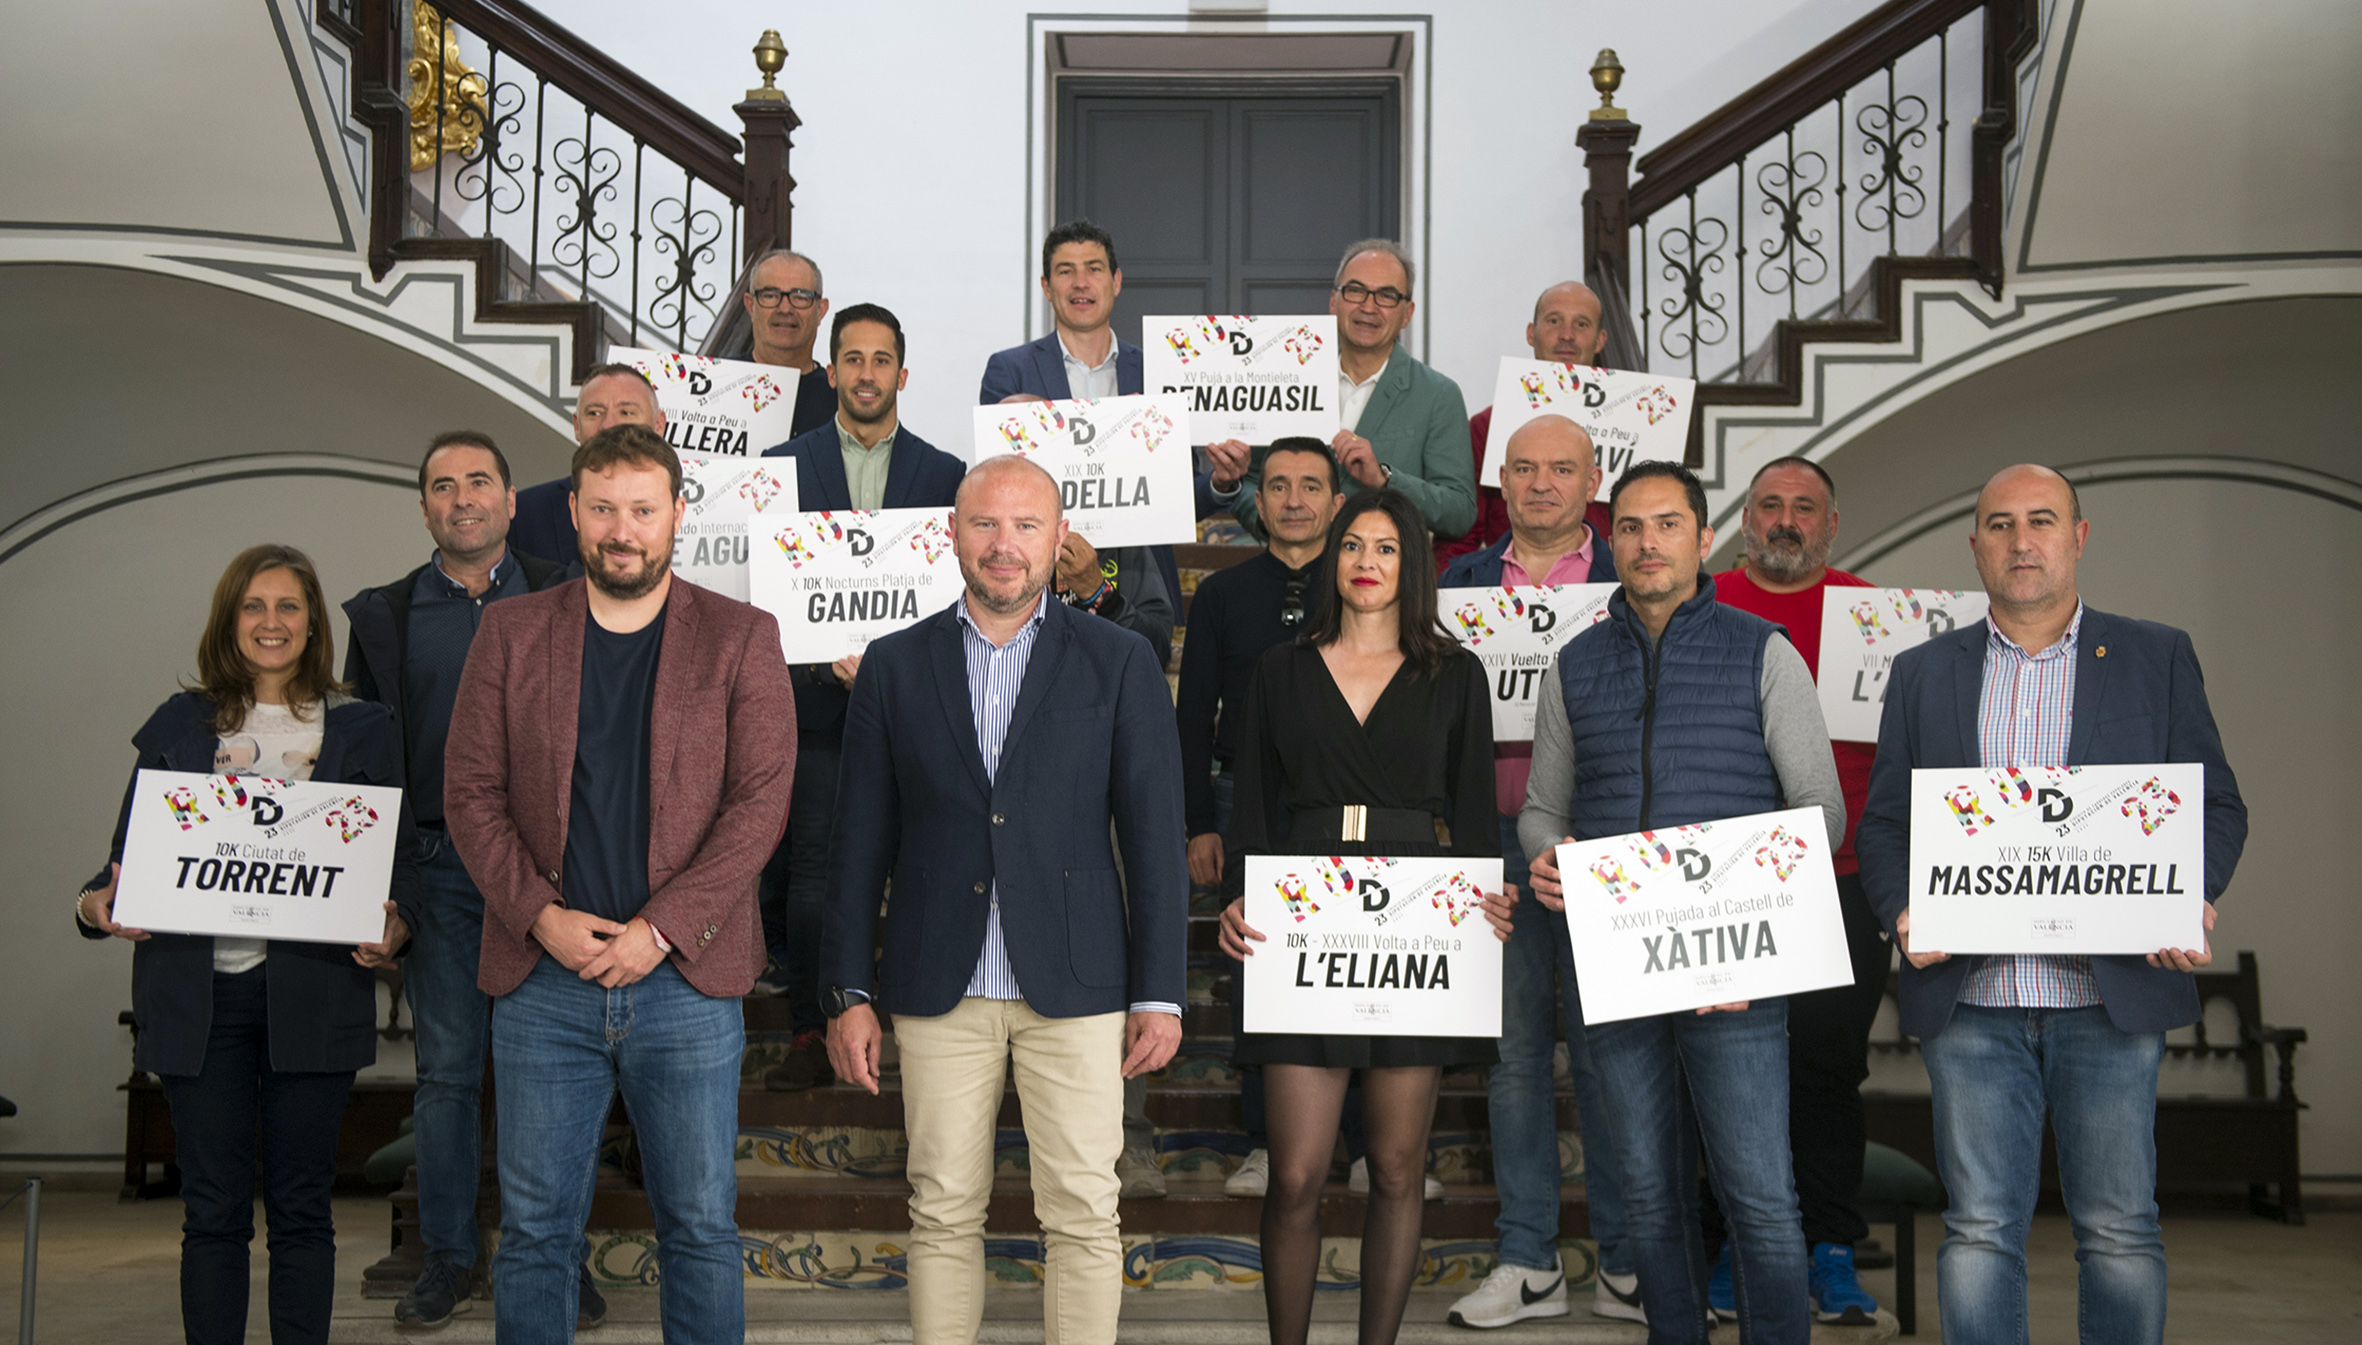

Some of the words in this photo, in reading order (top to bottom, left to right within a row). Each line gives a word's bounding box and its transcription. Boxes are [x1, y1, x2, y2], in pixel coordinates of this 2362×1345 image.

[1184, 372, 1197, 383] XV
[1225, 375, 1232, 383] a
[1234, 371, 1244, 383] la
[1246, 371, 1300, 383] Montieleta
[681, 409, 707, 423] Volta
[709, 415, 717, 424] a
[719, 414, 738, 427] Peu
[740, 420, 747, 429] a
[1600, 428, 1608, 438] a
[1610, 426, 1631, 441] Peu
[1064, 464, 1083, 478] XIX
[1086, 462, 1105, 477] 10K
[791, 577, 800, 591] X
[802, 576, 823, 590] 10K
[825, 575, 879, 590] Nocturns
[882, 573, 915, 589] Platja
[918, 572, 933, 586] de
[807, 588, 919, 624] GANDIA
[1511, 652, 1549, 666] Vuelta
[1862, 653, 1878, 667] VII
[264, 827, 278, 839] 23
[2055, 823, 2071, 838] 23
[215, 842, 241, 857] 10K
[242, 843, 285, 860] Ciutat
[288, 846, 306, 862] de
[1998, 846, 2021, 862] XIX
[2026, 845, 2052, 862] 15K
[2056, 845, 2088, 862] Villa
[2093, 845, 2112, 861] de
[175, 856, 345, 898] TORRENT
[1927, 863, 2185, 896] MASSAMAGRELL
[1699, 880, 1713, 895] 23
[1374, 913, 1388, 927] 23
[1610, 910, 1653, 932] XXXVI
[1655, 904, 1704, 927] Pujada
[1708, 902, 1722, 917] al
[1724, 893, 1773, 916] Castell
[1776, 891, 1794, 908] de
[1286, 933, 1309, 948] 10K
[1322, 933, 1369, 949] XXXVIII
[1373, 934, 1407, 950] Volta
[1411, 938, 1420, 950] a
[1424, 935, 1449, 951] Peu
[1454, 938, 1462, 951] a
[1641, 919, 1778, 974] XÀTIVA
[1295, 952, 1450, 990] L'ELIANA
